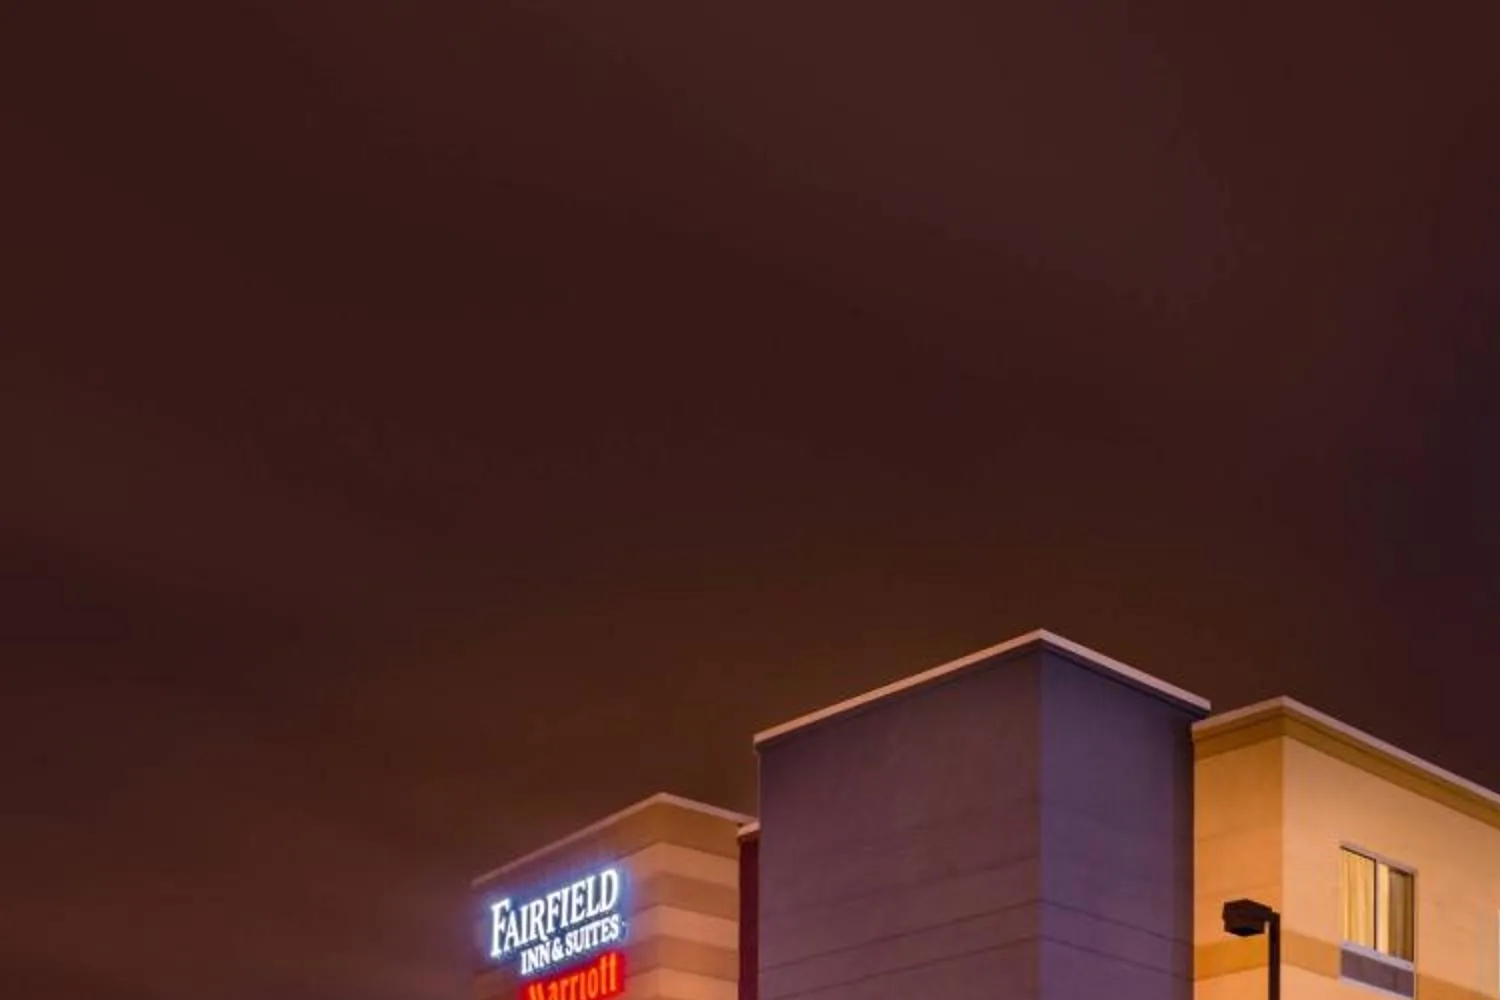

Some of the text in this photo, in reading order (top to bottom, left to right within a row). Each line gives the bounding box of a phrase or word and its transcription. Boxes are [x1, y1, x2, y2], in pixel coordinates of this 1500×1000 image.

[490, 868, 620, 958] FAIRFIELD
[521, 913, 620, 975] INN & SUITES
